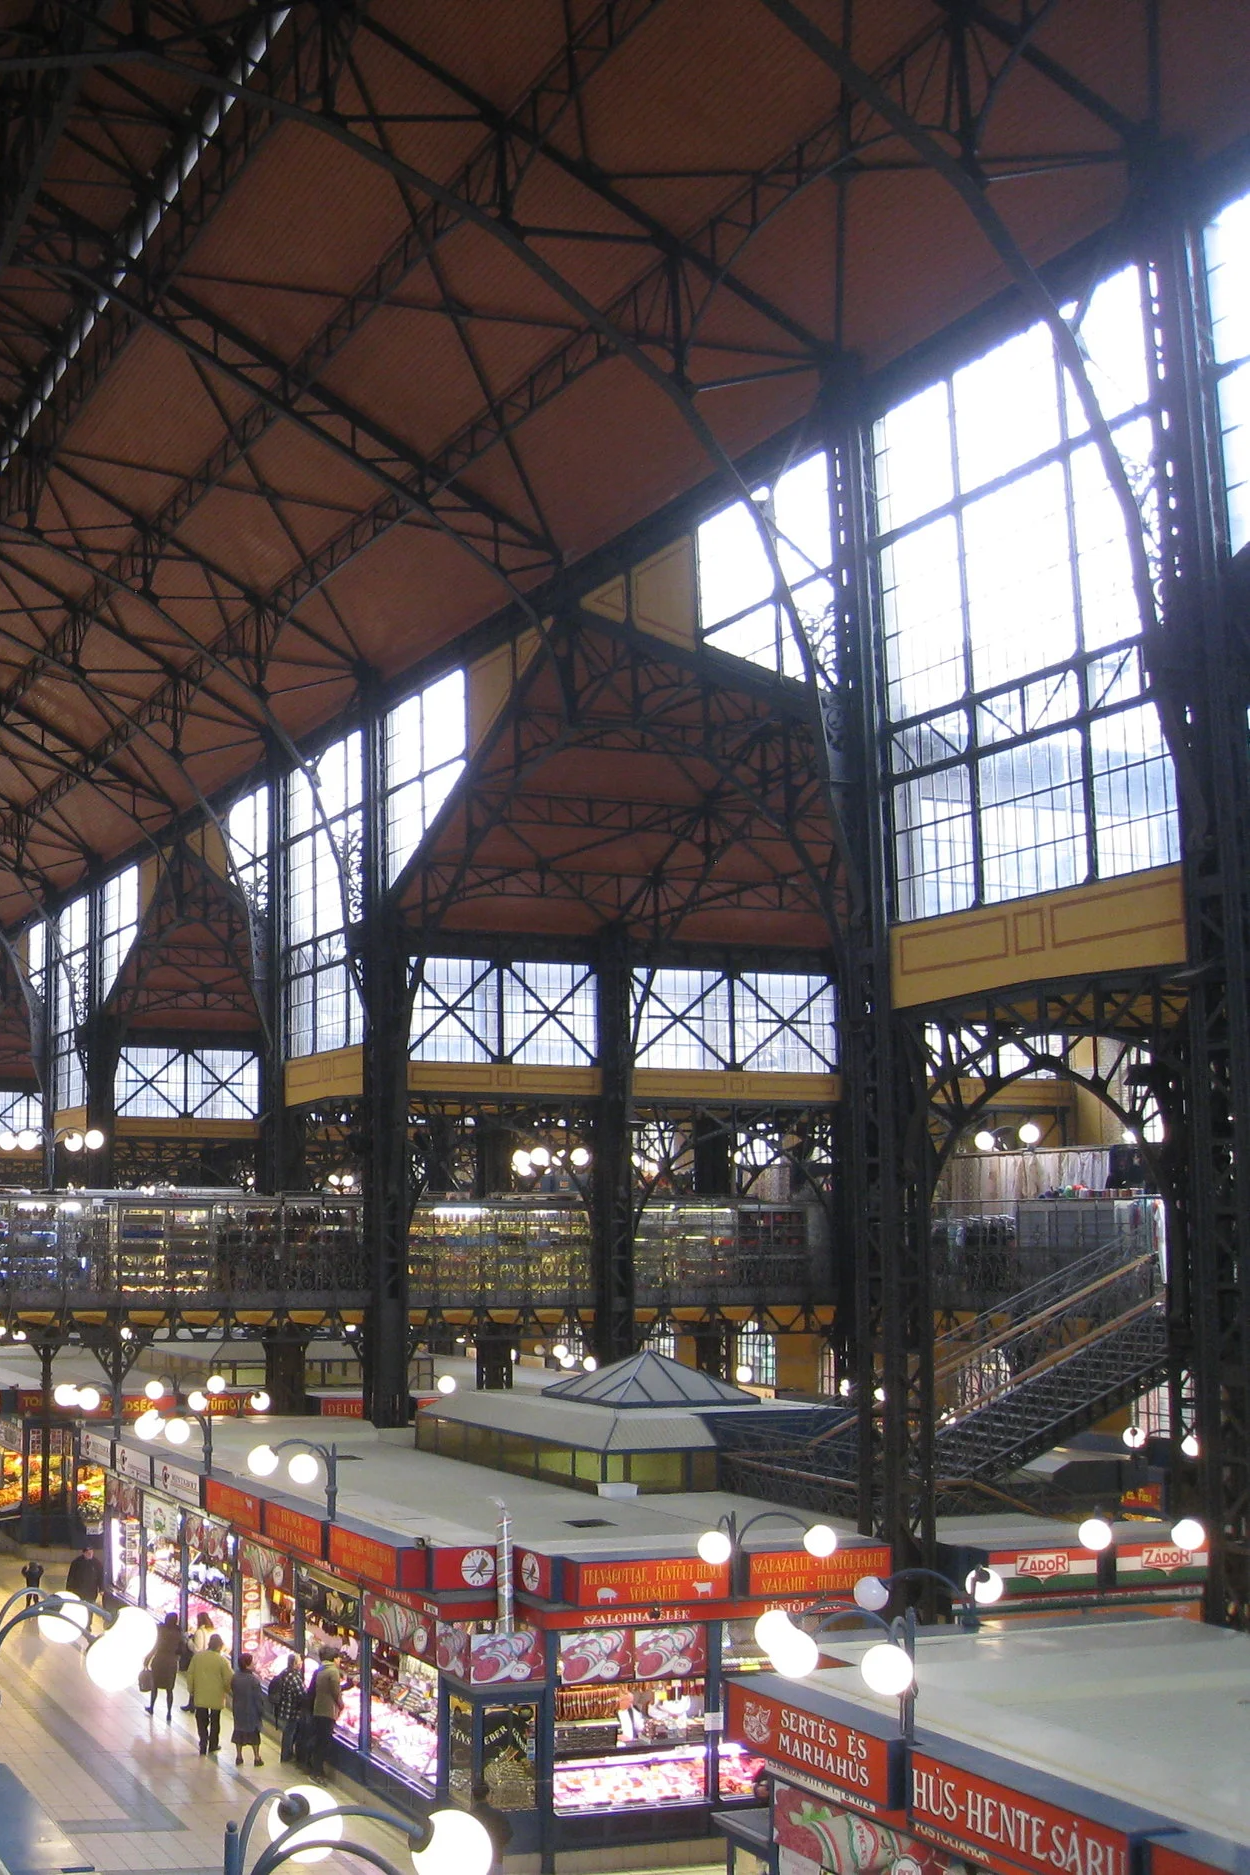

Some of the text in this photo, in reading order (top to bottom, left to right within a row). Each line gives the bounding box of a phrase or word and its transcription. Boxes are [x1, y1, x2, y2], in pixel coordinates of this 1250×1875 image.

[1018, 1555, 1067, 1573] ZÁDOR
[1144, 1548, 1189, 1565] ZÁDOR
[583, 1607, 690, 1626] SZALONNAÉLÉK
[780, 1708, 868, 1760] SERTÉS ÉS
[778, 1733, 870, 1788] MARHAHÚS
